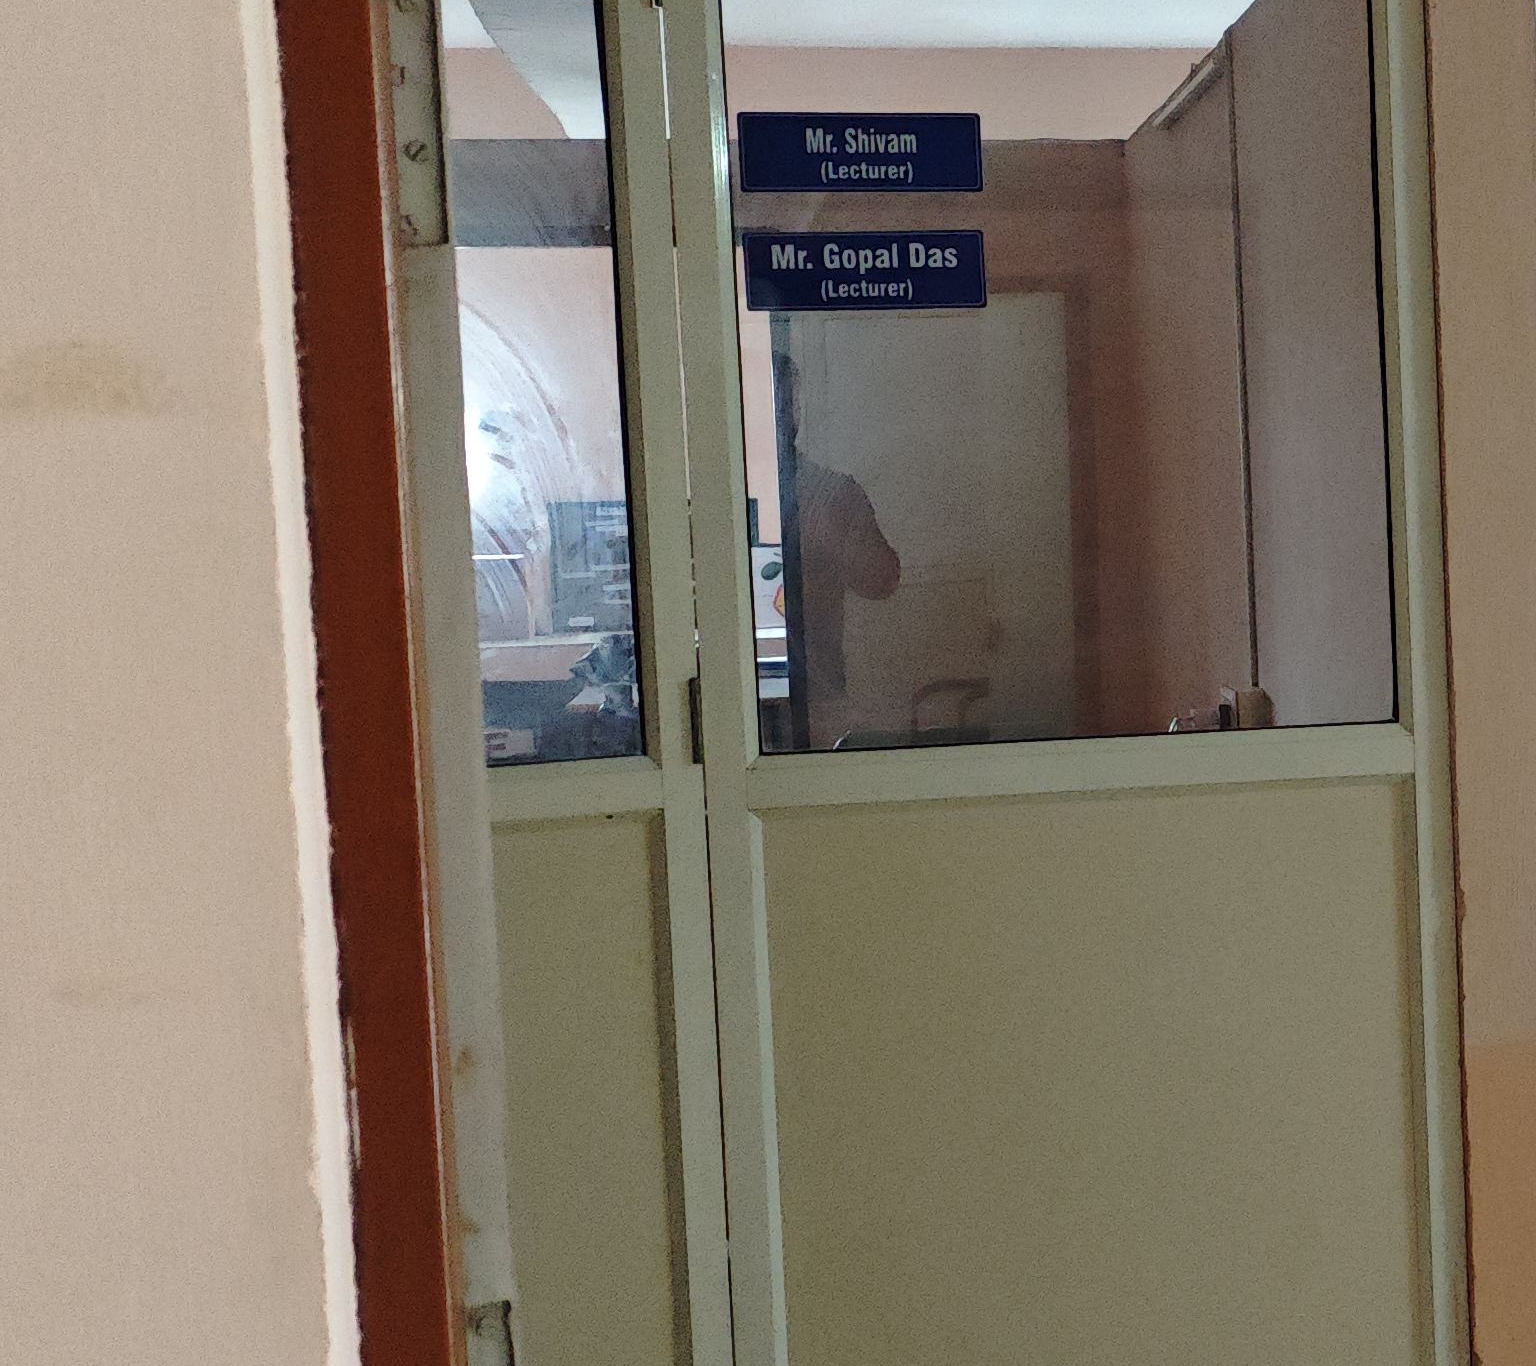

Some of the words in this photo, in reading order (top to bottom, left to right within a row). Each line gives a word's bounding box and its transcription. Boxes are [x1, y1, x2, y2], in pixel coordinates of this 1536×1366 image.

[805, 127, 838, 154] Mr.
[844, 127, 917, 154] Shivam
[820, 161, 914, 183] (Lecturer)
[771, 244, 814, 270] Mr.
[823, 243, 899, 274] Gopal
[908, 243, 958, 268] Das
[820, 279, 914, 302] (Lecturer)
